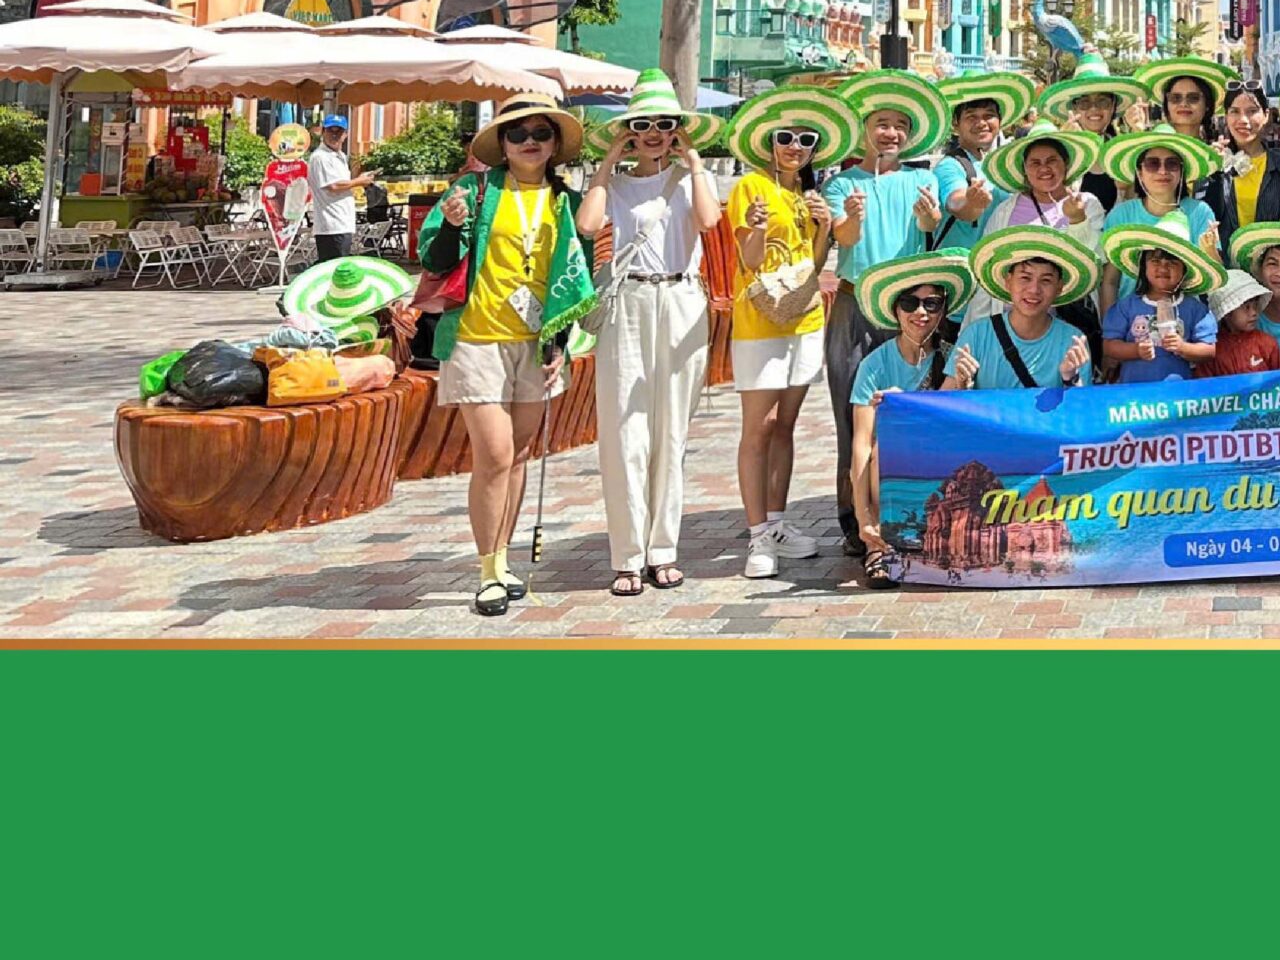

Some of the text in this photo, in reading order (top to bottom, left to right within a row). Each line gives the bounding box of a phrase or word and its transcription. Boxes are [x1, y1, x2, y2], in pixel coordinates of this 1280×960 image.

[1109, 402, 1169, 424] MĂNG
[1173, 395, 1244, 417] TRAVEL
[1063, 438, 1177, 472] TRƯỜNG
[980, 488, 1099, 527] Tham
[1106, 486, 1217, 529] quan
[1222, 475, 1280, 511] du
[1186, 538, 1226, 559] Ngày
[1230, 537, 1252, 554] 04
